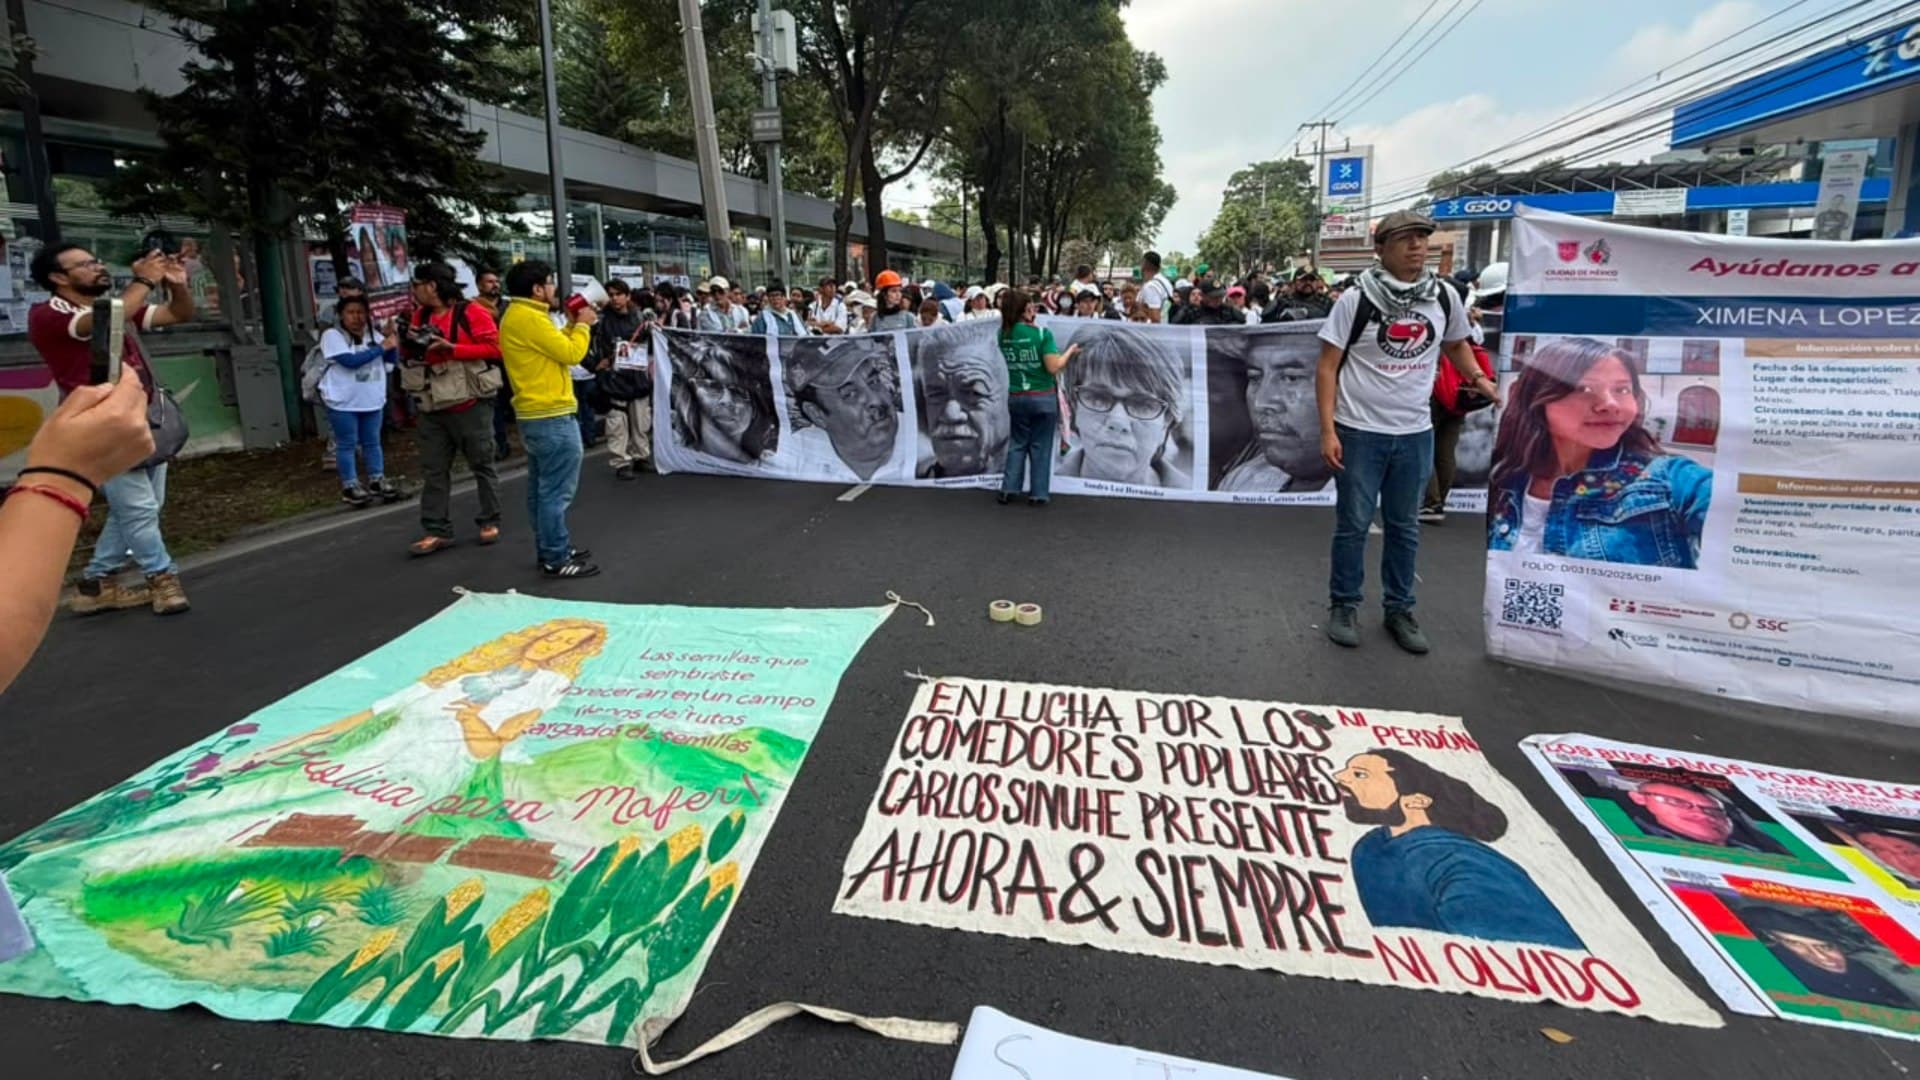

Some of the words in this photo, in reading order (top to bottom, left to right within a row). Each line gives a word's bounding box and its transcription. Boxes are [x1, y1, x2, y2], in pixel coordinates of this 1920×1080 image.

[1464, 199, 1512, 213] G500
[1688, 257, 1881, 277] Ayúdanos
[1696, 307, 1808, 326] XIMENA
[1790, 364, 1805, 372] de
[1789, 375, 1804, 383] de
[1756, 618, 1789, 632] SSC
[640, 648, 674, 662] Las
[676, 649, 761, 664] semillas
[765, 656, 809, 669] que
[736, 694, 816, 710] campo
[926, 682, 988, 717] EN
[995, 688, 1124, 734] LUCHA
[1136, 697, 1224, 740] POR
[1230, 705, 1334, 753] LOS
[1336, 708, 1369, 728] NI
[1371, 724, 1482, 754] PERDÓN
[899, 714, 1144, 783] COMEDORES
[1156, 740, 1344, 806] POPULARES
[1594, 747, 1749, 777] BUSCAMOS
[1749, 767, 1876, 797] PORQUE
[1001, 777, 1131, 841] SINUHE
[1136, 790, 1348, 866] PRESENTE
[844, 827, 1058, 922] AHORA
[1058, 842, 1124, 935] &
[1131, 847, 1376, 960] SIEMPRE
[1372, 934, 1440, 985] NI
[1443, 942, 1642, 1009] OLVIDO
